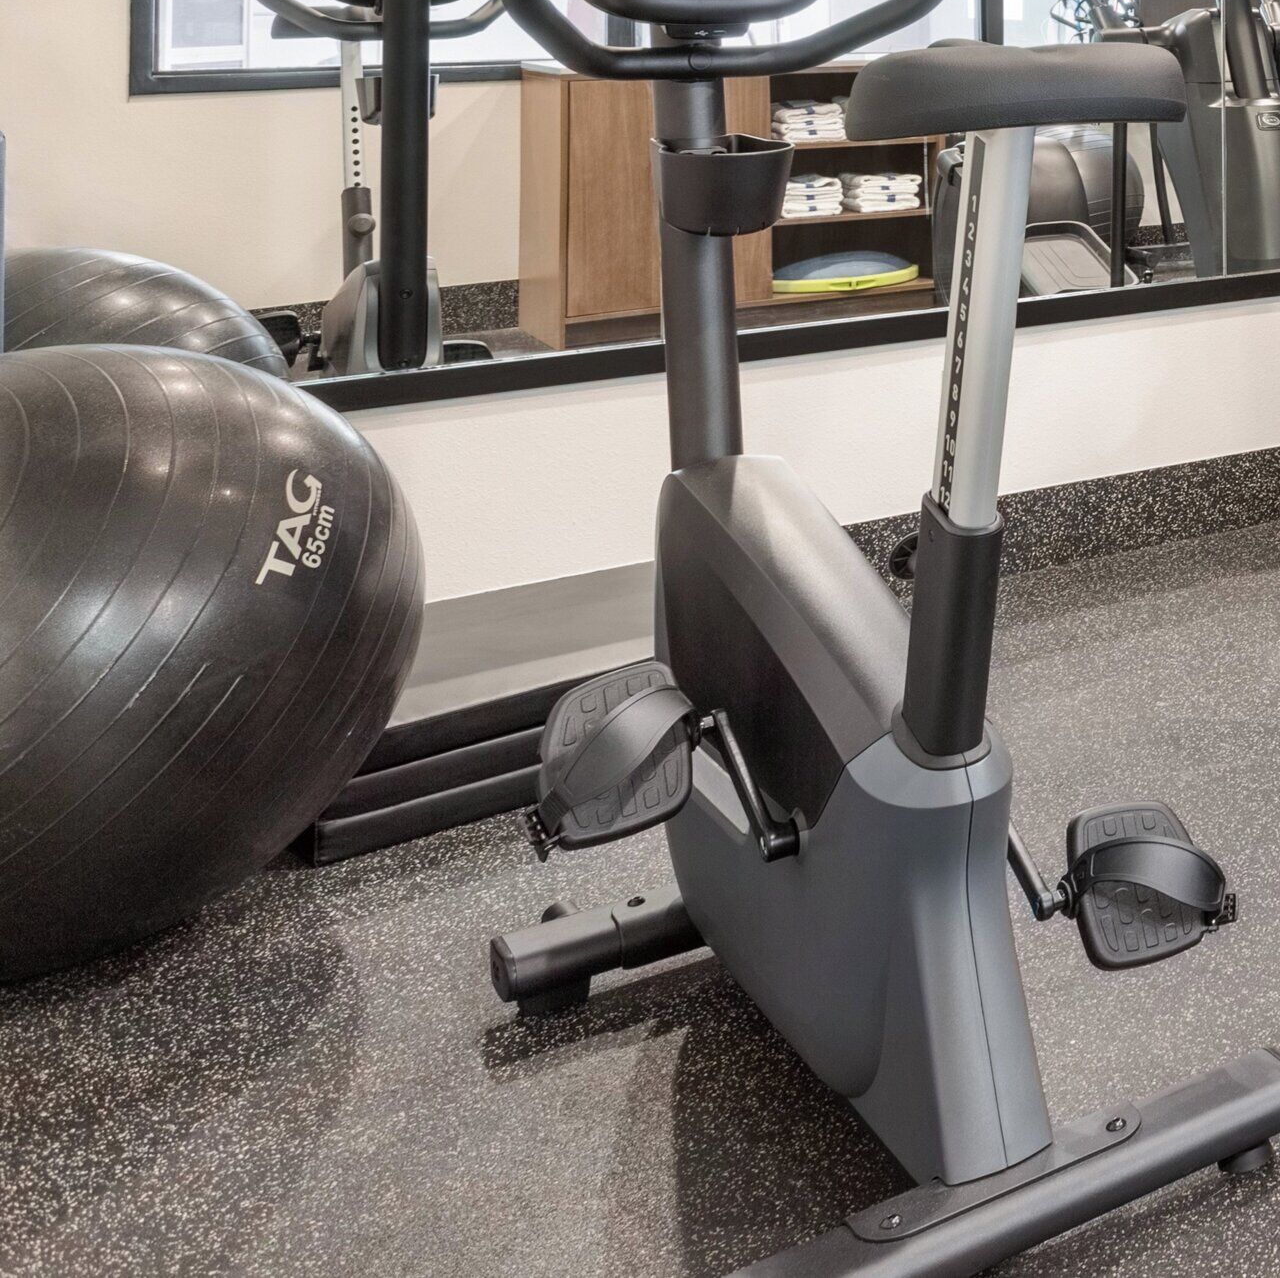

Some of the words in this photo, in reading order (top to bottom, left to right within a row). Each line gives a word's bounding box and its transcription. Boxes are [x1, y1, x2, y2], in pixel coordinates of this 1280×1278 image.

[971, 194, 977, 213] 1
[967, 222, 975, 241] 2
[964, 249, 972, 268] 3
[962, 277, 969, 296] 4
[959, 303, 967, 322] 5
[956, 331, 964, 349] 6
[955, 355, 962, 374] 7
[951, 383, 959, 401] 8
[949, 410, 956, 428] 9
[945, 433, 956, 457] 10
[943, 459, 953, 483] 11
[255, 468, 323, 585] TAG
[302, 504, 336, 569] 65cm
